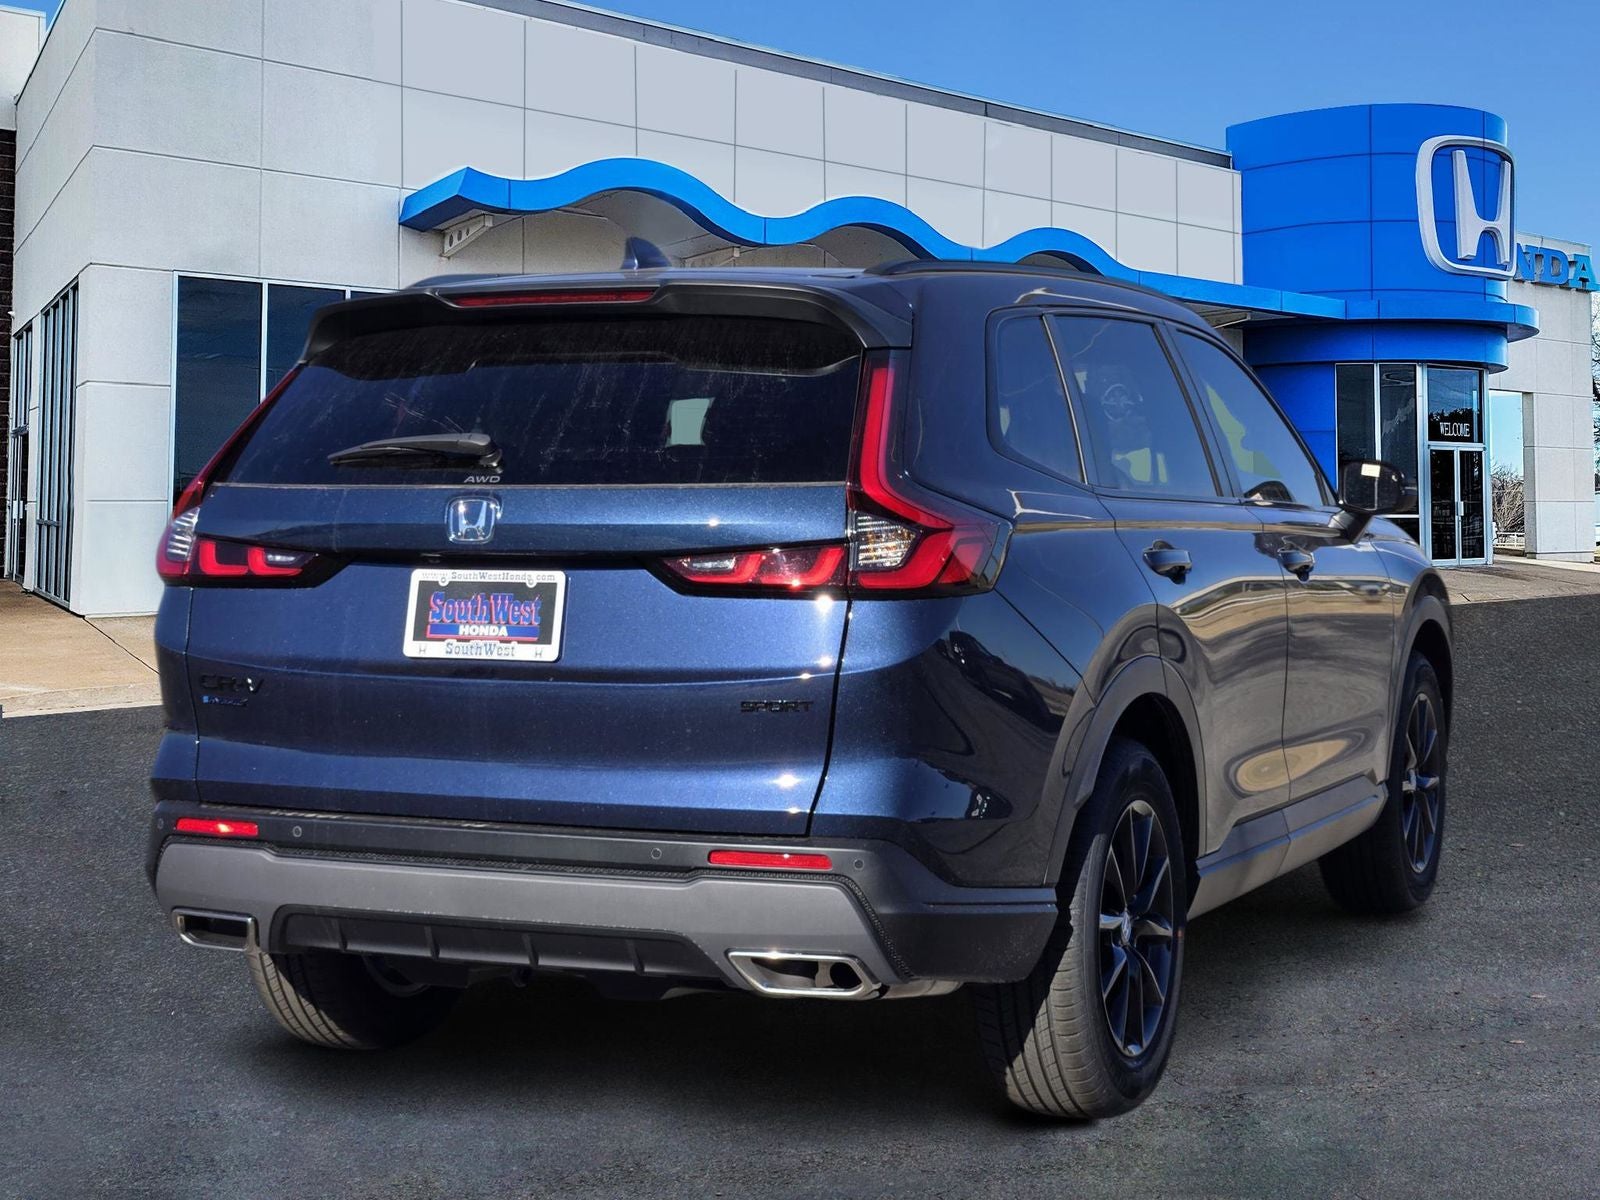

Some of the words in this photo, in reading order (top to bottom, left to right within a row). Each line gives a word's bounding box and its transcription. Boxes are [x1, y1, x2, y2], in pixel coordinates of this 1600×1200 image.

[1439, 422, 1471, 437] WELCOME
[463, 475, 501, 483] AWD
[458, 624, 508, 637] HONDA
[445, 641, 516, 657] SouthWest
[741, 700, 814, 713] SPORT
